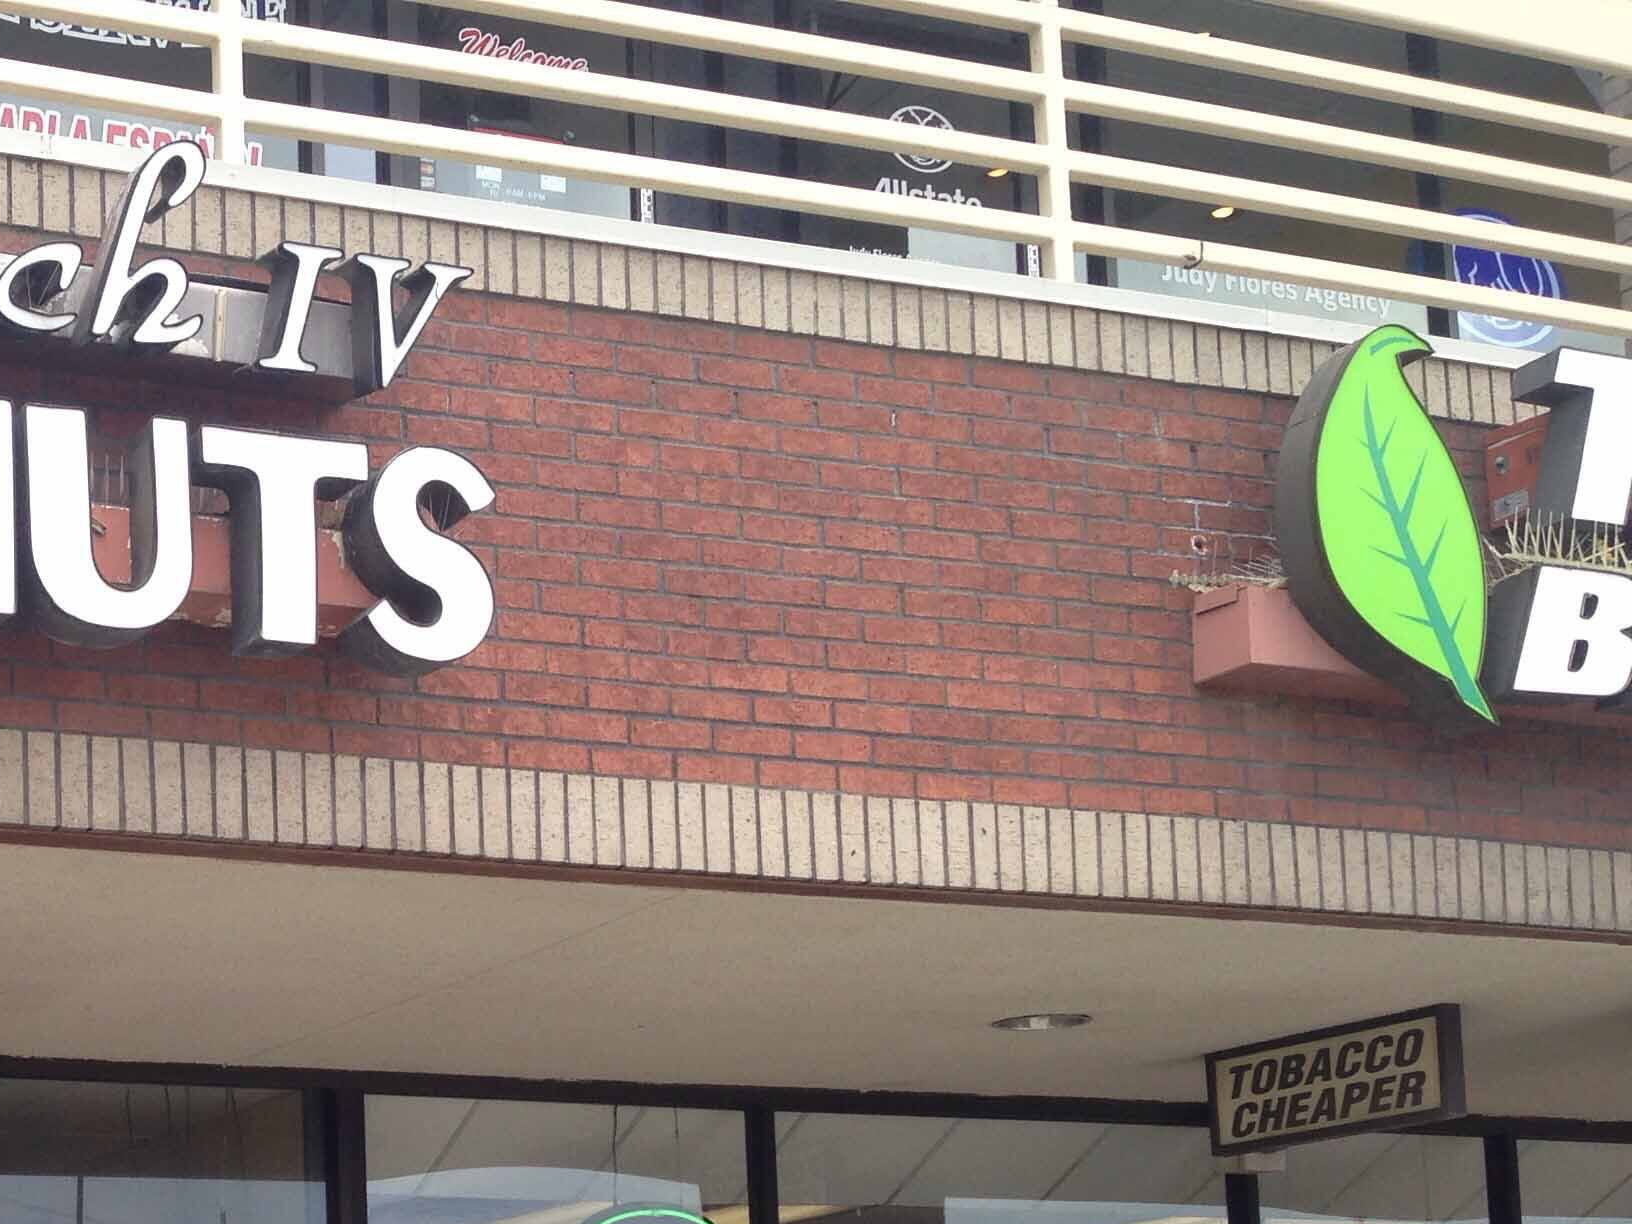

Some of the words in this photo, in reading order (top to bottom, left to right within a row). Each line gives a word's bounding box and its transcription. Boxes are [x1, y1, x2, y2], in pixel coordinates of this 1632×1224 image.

[258, 242, 472, 392] IV
[1162, 265, 1217, 292] Judy
[1304, 285, 1392, 318] Agency
[1229, 1028, 1424, 1100] TOBACCO
[1231, 1070, 1426, 1138] CHEAPER
